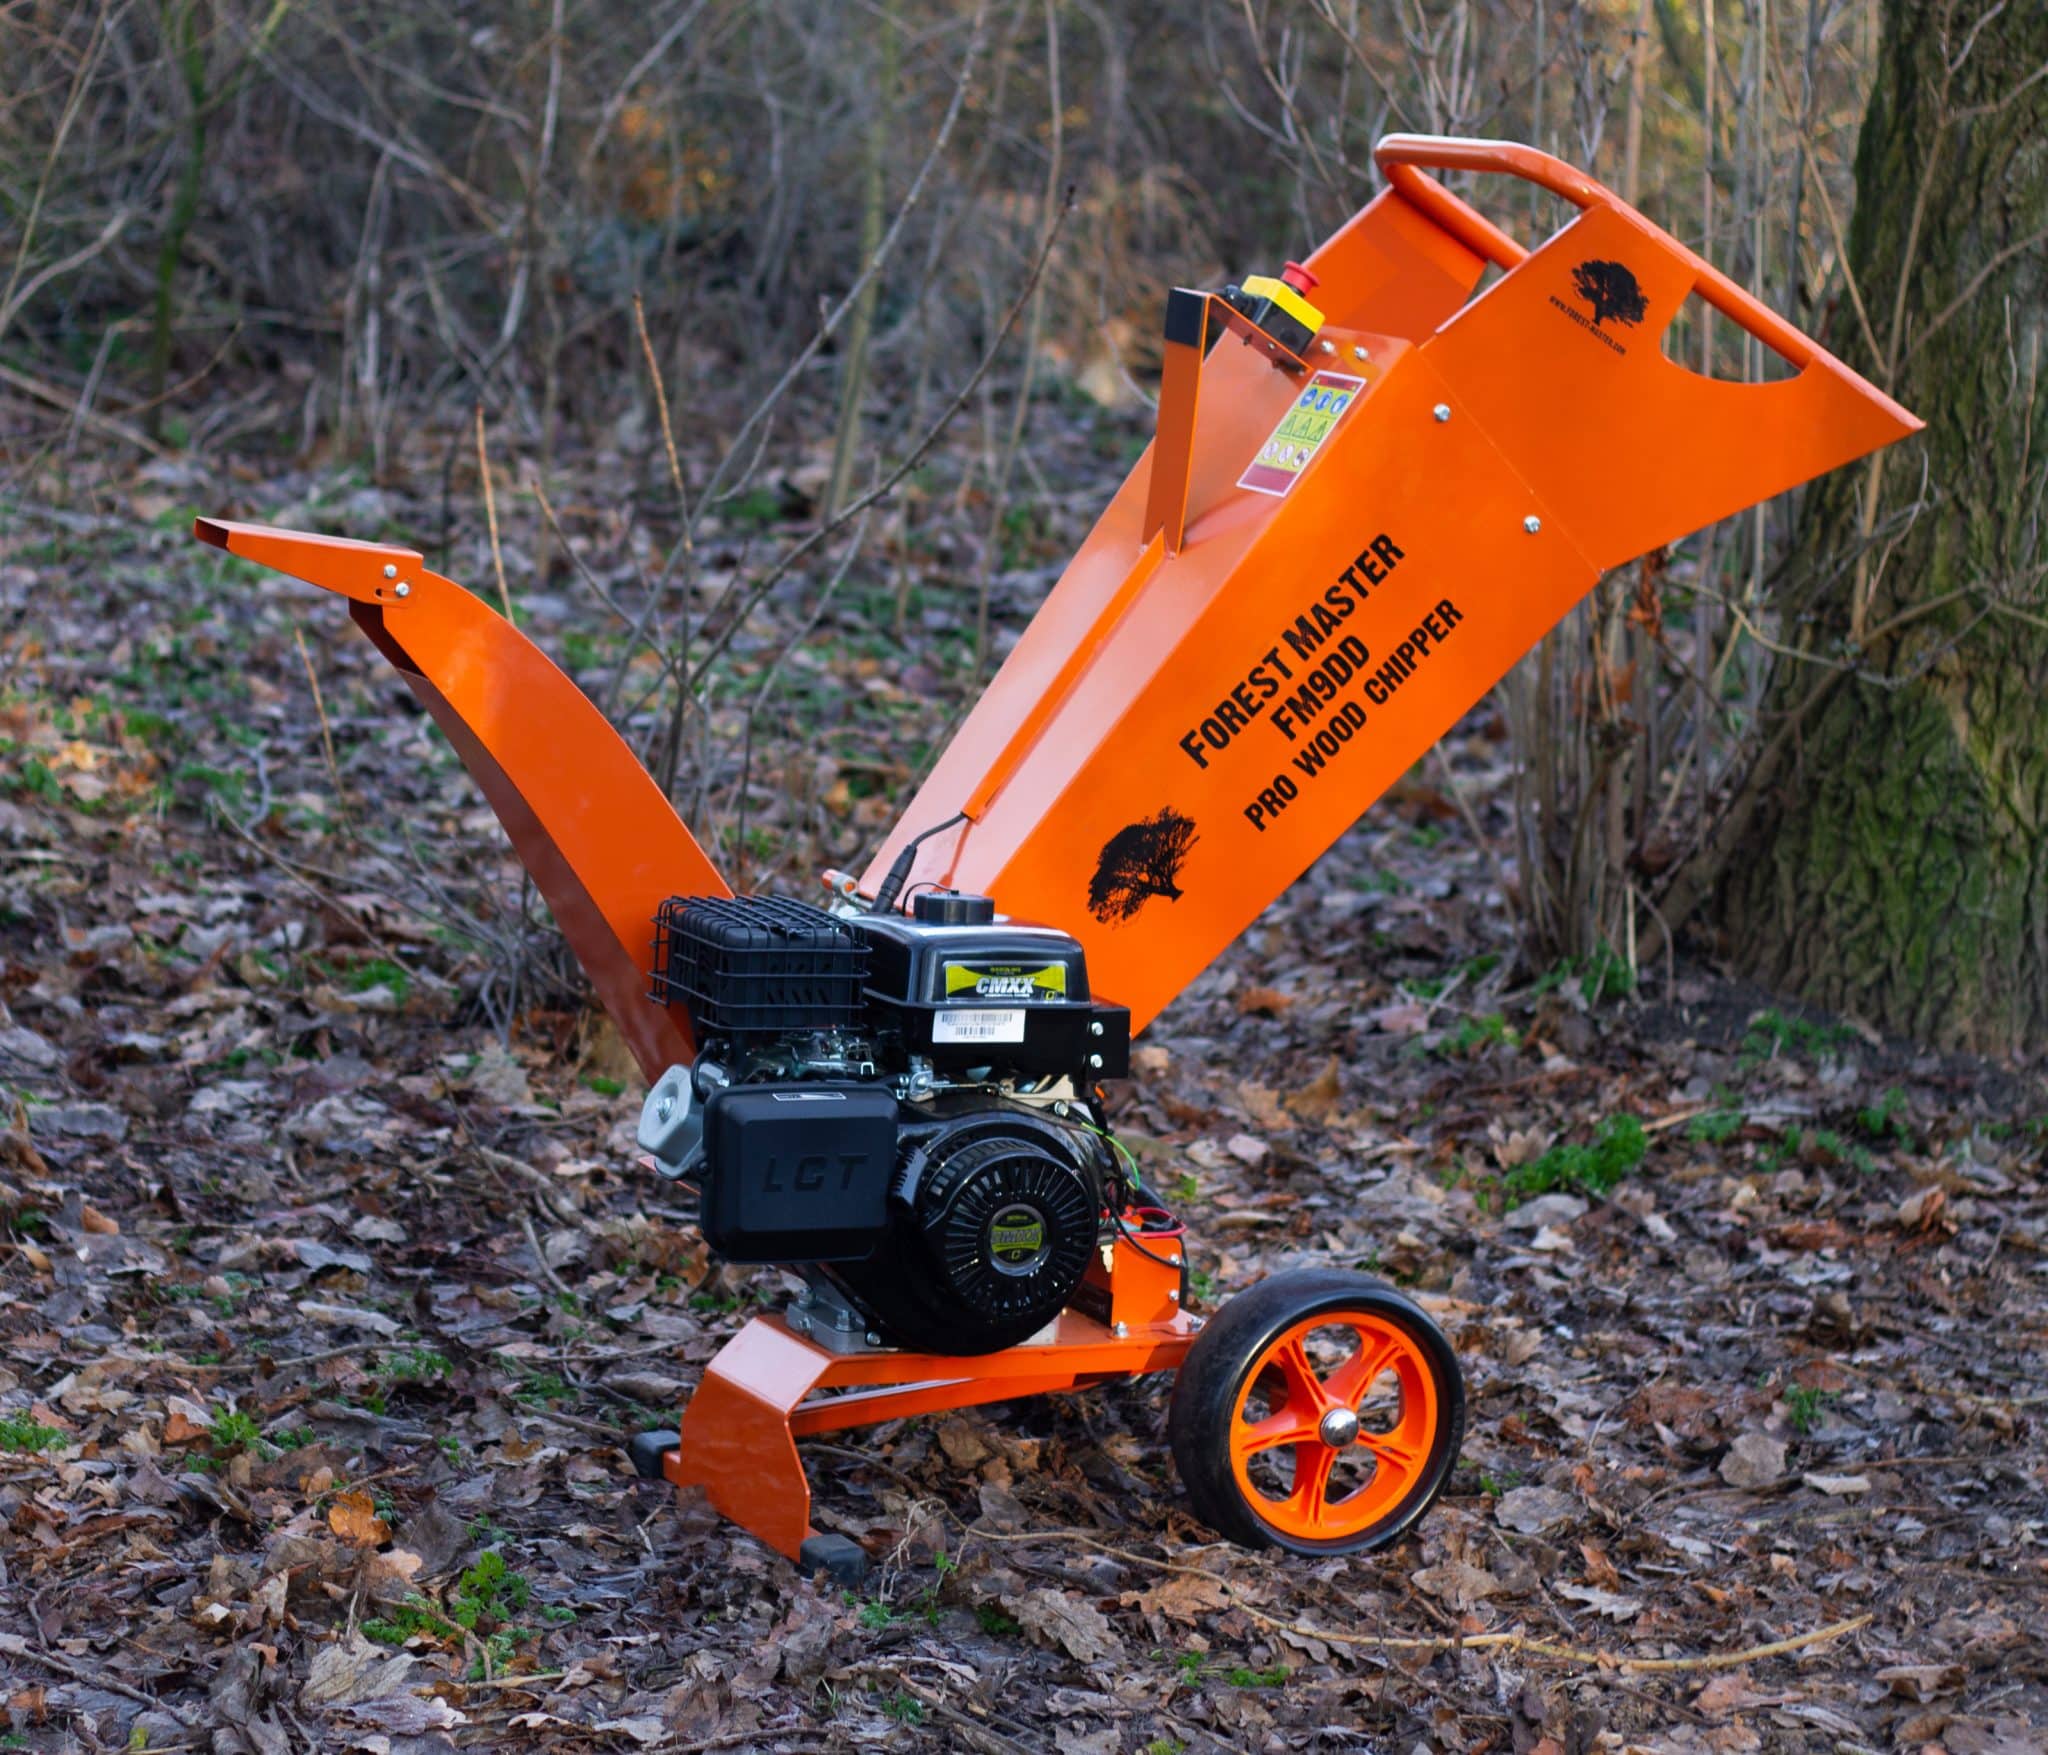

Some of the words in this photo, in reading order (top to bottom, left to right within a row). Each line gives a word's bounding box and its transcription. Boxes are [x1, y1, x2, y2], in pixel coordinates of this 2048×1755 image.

[1179, 647, 1294, 769] FOREST
[1282, 533, 1406, 661] MASTER
[1243, 773, 1298, 832] PRO
[1292, 700, 1367, 777] WOOD
[1363, 598, 1465, 705] CHIPPER
[1270, 635, 1371, 741] FM9DD
[976, 976, 1035, 994] CMXX
